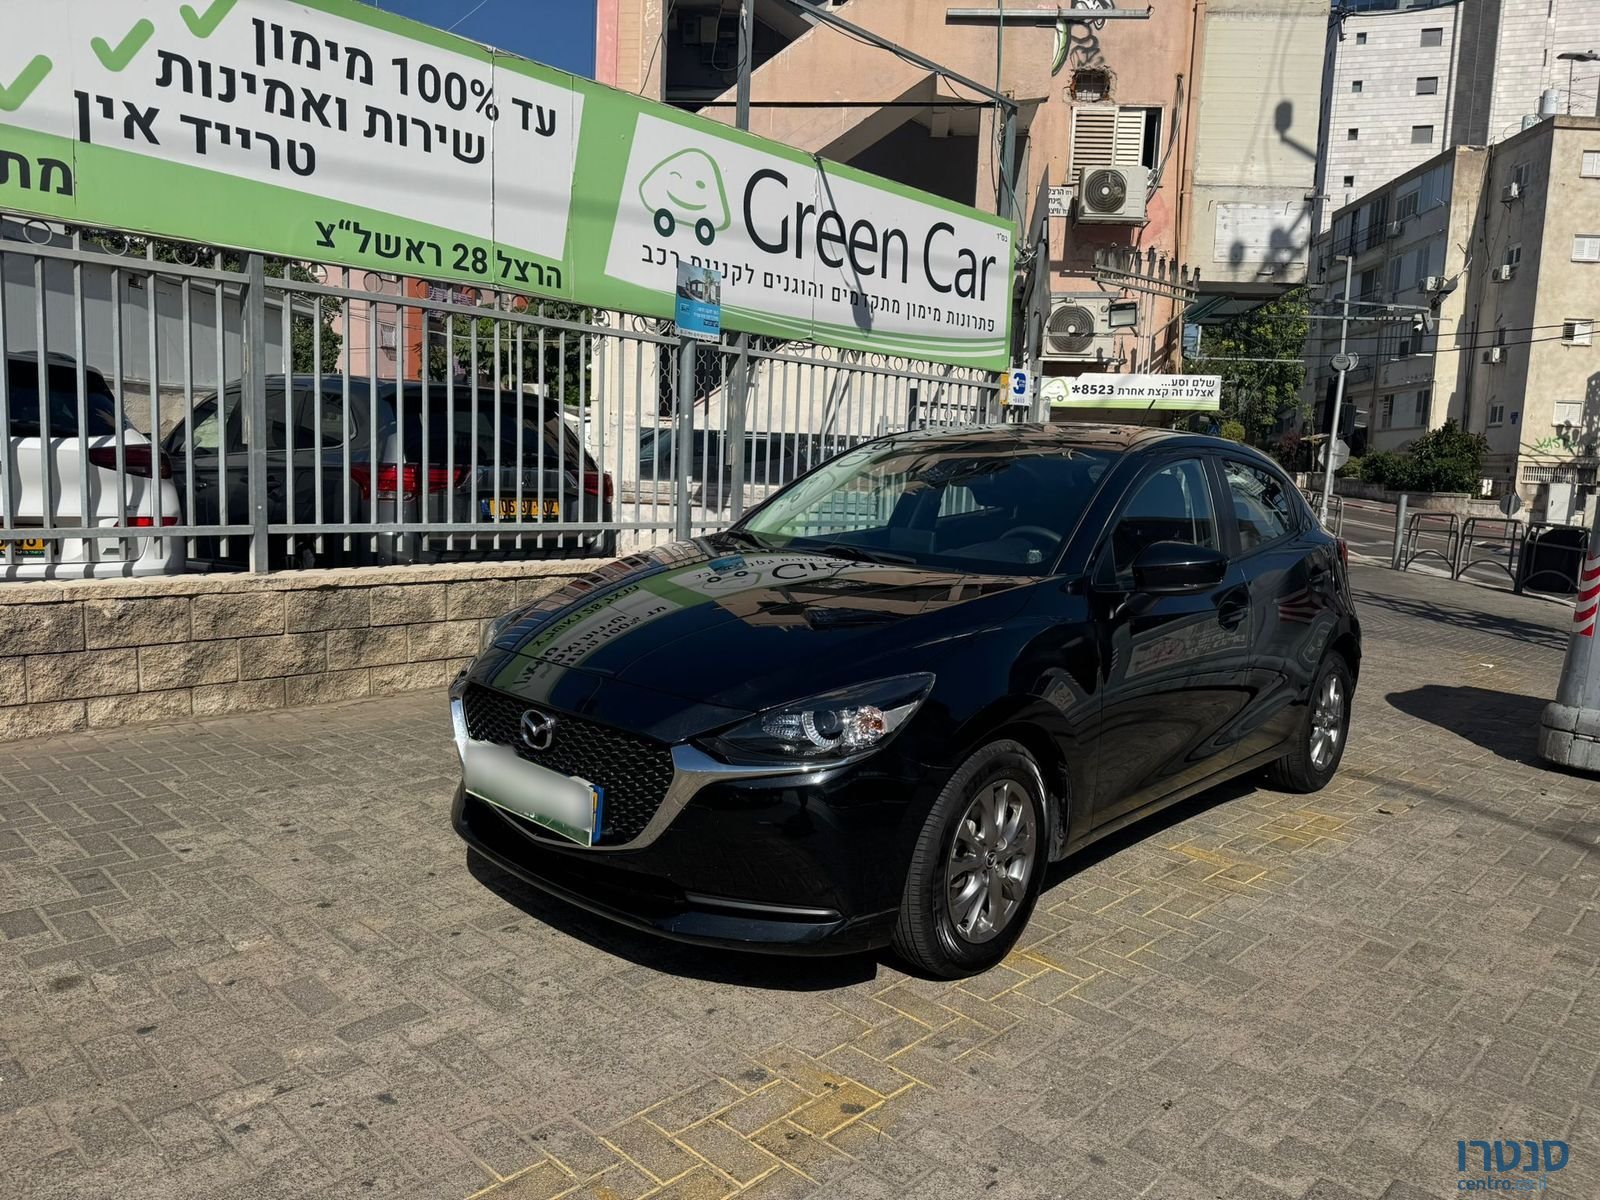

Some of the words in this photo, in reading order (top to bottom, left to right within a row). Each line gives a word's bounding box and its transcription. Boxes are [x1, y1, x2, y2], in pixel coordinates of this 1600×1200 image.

[252, 17, 373, 86] מימון
[156, 49, 347, 132] ואמינות
[391, 57, 499, 121] 100%
[74, 89, 160, 146] אין
[512, 97, 556, 137] עד
[180, 113, 316, 177] טרייד
[363, 104, 485, 164] שירות
[743, 168, 908, 284] Green
[923, 221, 997, 301] Car
[452, 243, 488, 274] 28
[497, 249, 562, 289] הרצל
[641, 244, 680, 268] רכב
[763, 271, 824, 300] והוגנים
[831, 285, 900, 314] מתקדמים
[906, 301, 941, 322] מימון
[946, 310, 996, 332] פתרונות
[1117, 386, 1145, 396] אחרת
[1147, 387, 1169, 398] קצת
[1172, 387, 1182, 396] זה
[1186, 387, 1214, 397] אצלנו
[1192, 378, 1215, 387] שלם
